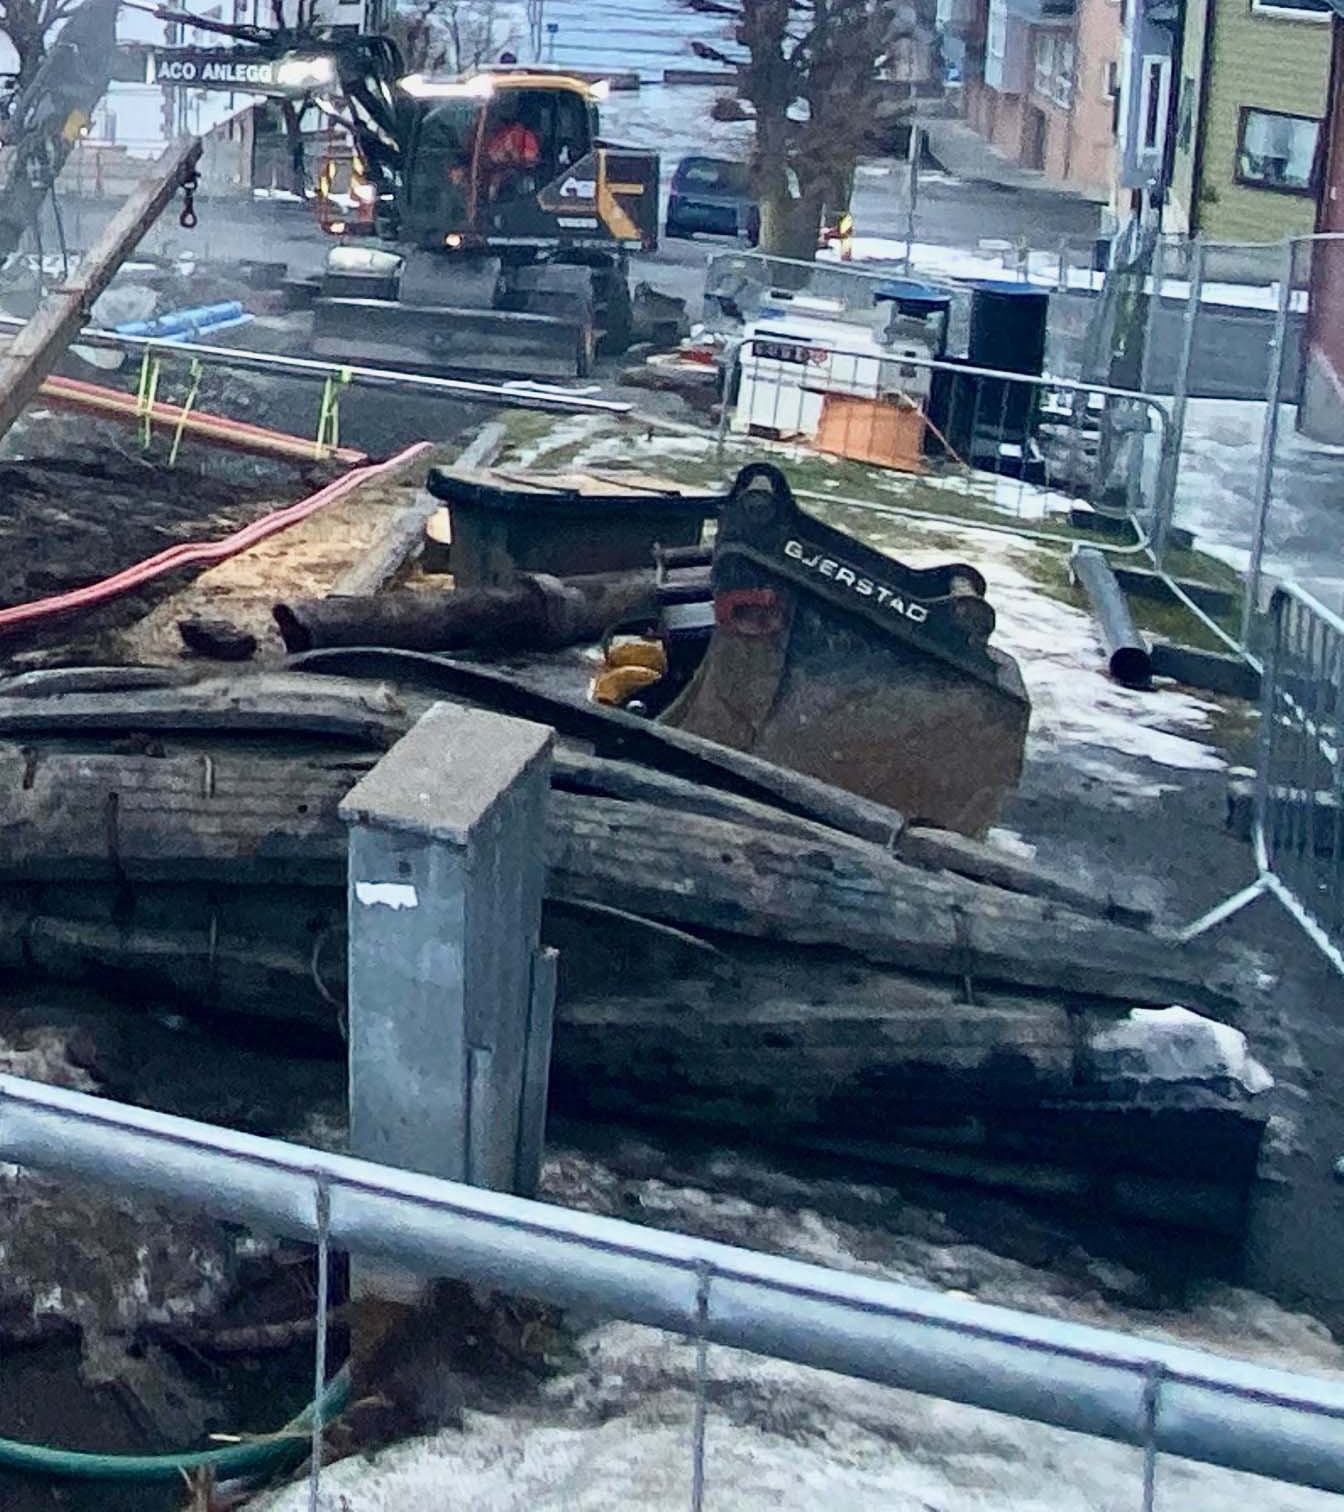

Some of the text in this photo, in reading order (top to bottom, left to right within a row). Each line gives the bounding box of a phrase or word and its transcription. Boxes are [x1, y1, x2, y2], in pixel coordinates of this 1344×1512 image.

[157, 61, 273, 82] ACO ANLEGG
[783, 539, 929, 624] GJERSTAD
